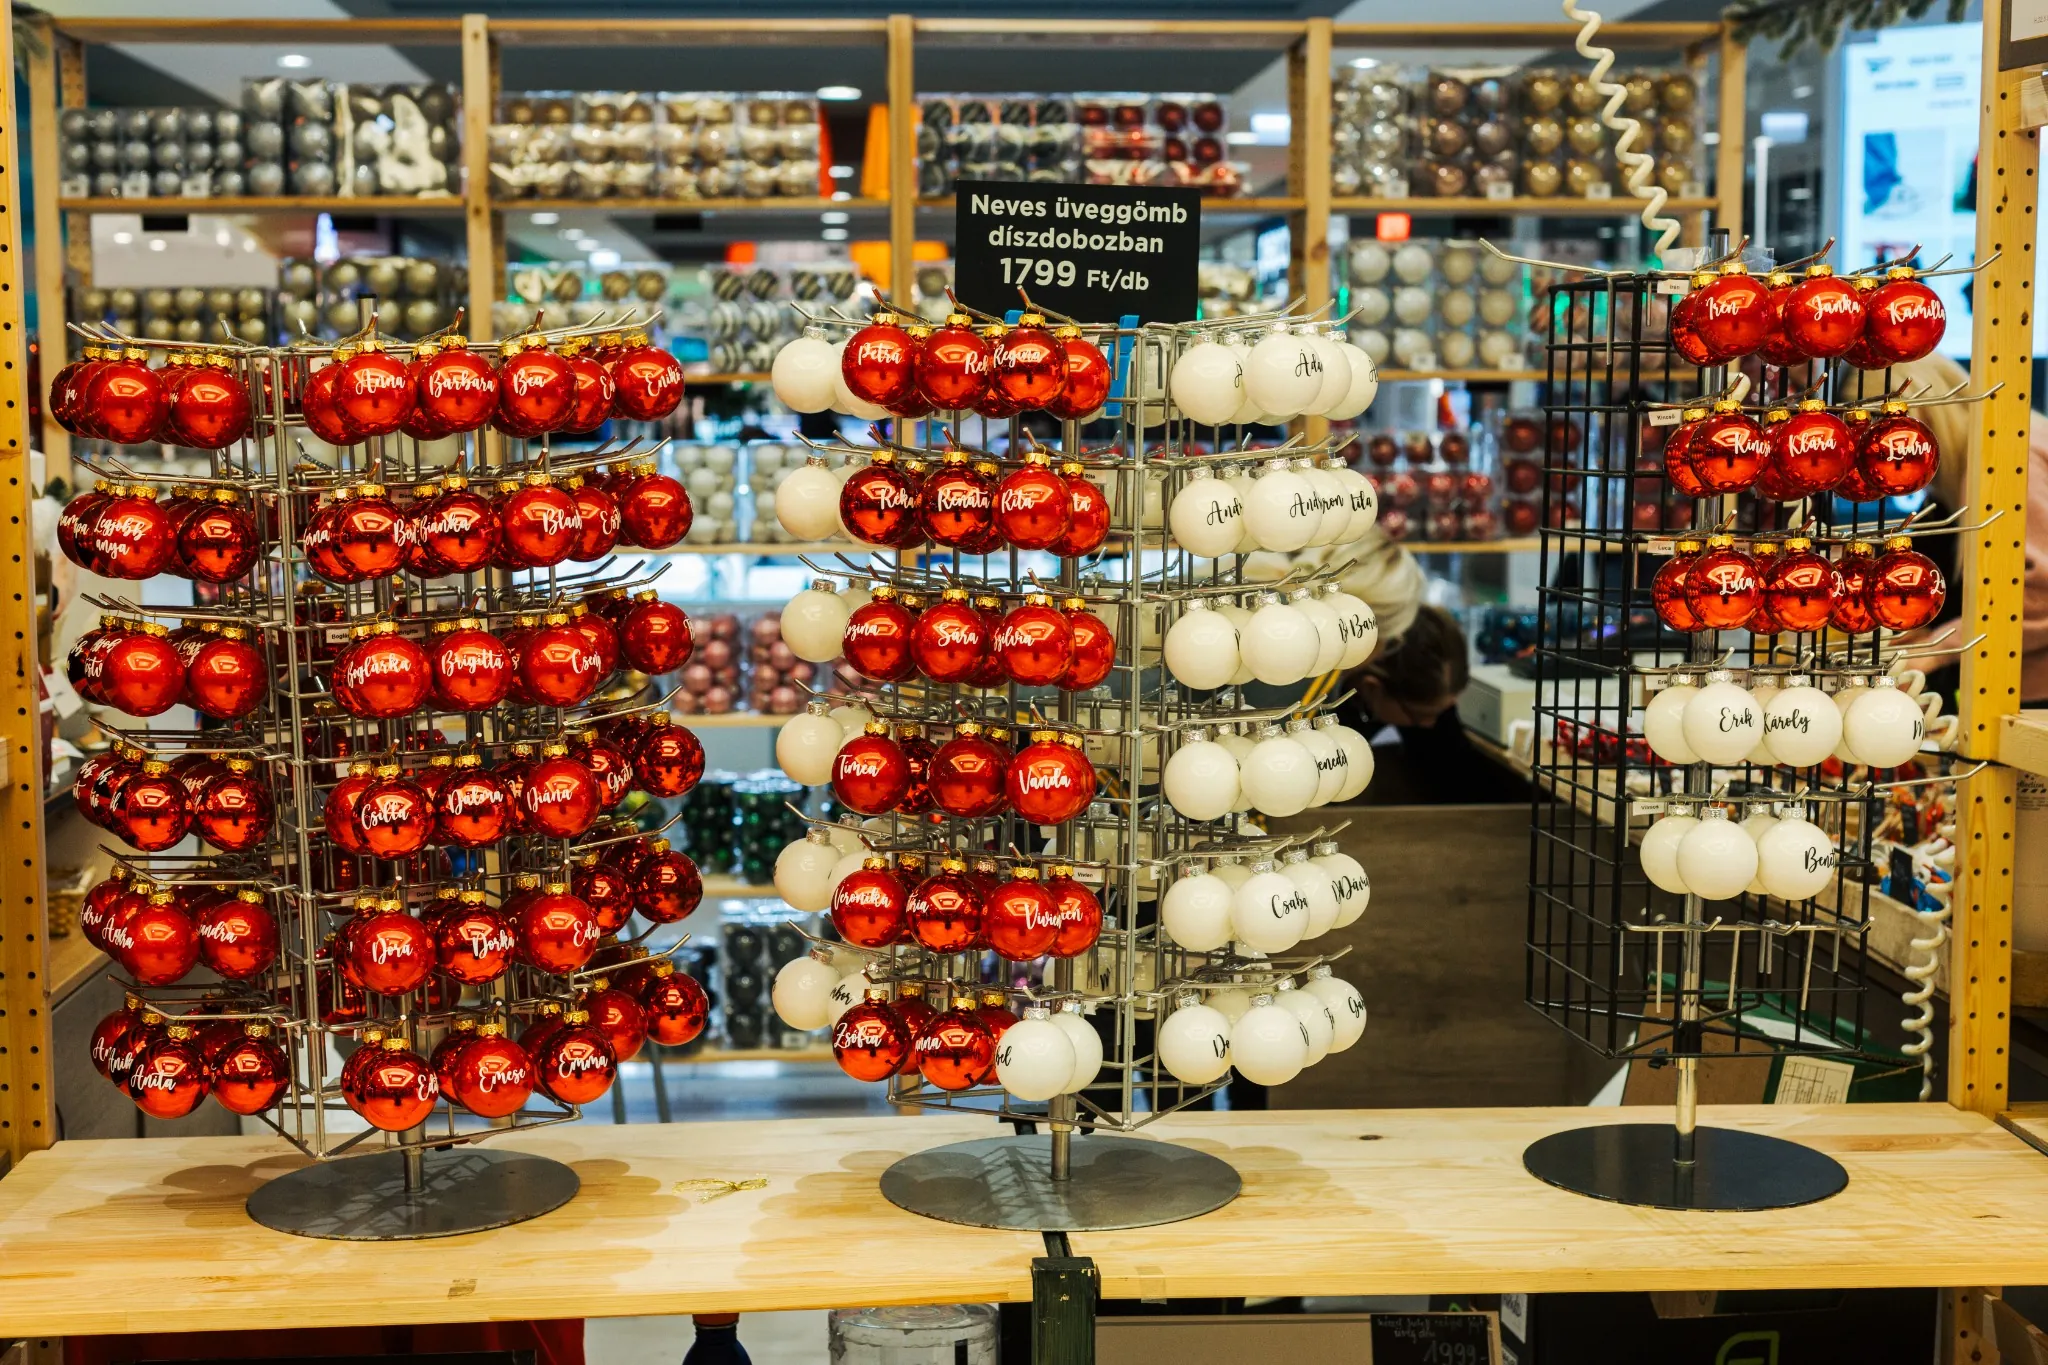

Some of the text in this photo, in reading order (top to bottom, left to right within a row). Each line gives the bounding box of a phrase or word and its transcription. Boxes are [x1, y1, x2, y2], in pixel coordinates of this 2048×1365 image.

[971, 194, 1187, 225] Neves üveggömb
[988, 225, 1163, 253] díszdobozban
[1000, 257, 1149, 291] 1799 Ft/db
[1811, 295, 1860, 321] Janka
[858, 342, 902, 366] Petra
[993, 344, 1042, 369] Regina
[355, 368, 405, 395] Anna
[430, 369, 495, 398] Barbara
[513, 368, 545, 396] Bea
[1887, 438, 1931, 462] Laura
[1001, 488, 1035, 513] Rita
[94, 511, 146, 541] Legjobb
[96, 539, 130, 559] anya
[1719, 570, 1756, 596] Luca
[937, 622, 979, 647] Sára
[441, 648, 504, 677] Brigitta
[1718, 706, 1754, 733] Erik
[1763, 708, 1811, 735] Károly
[1019, 768, 1071, 795] Vanda
[526, 786, 573, 813] Diána
[361, 803, 409, 830] Csilla
[834, 887, 890, 911] Veronika
[1271, 890, 1308, 919] Csaba
[198, 920, 238, 944] andra
[833, 1022, 882, 1048] Zsófia
[131, 1063, 176, 1091] Anita
[558, 1052, 609, 1078] Emma
[480, 1066, 526, 1093] Emese
